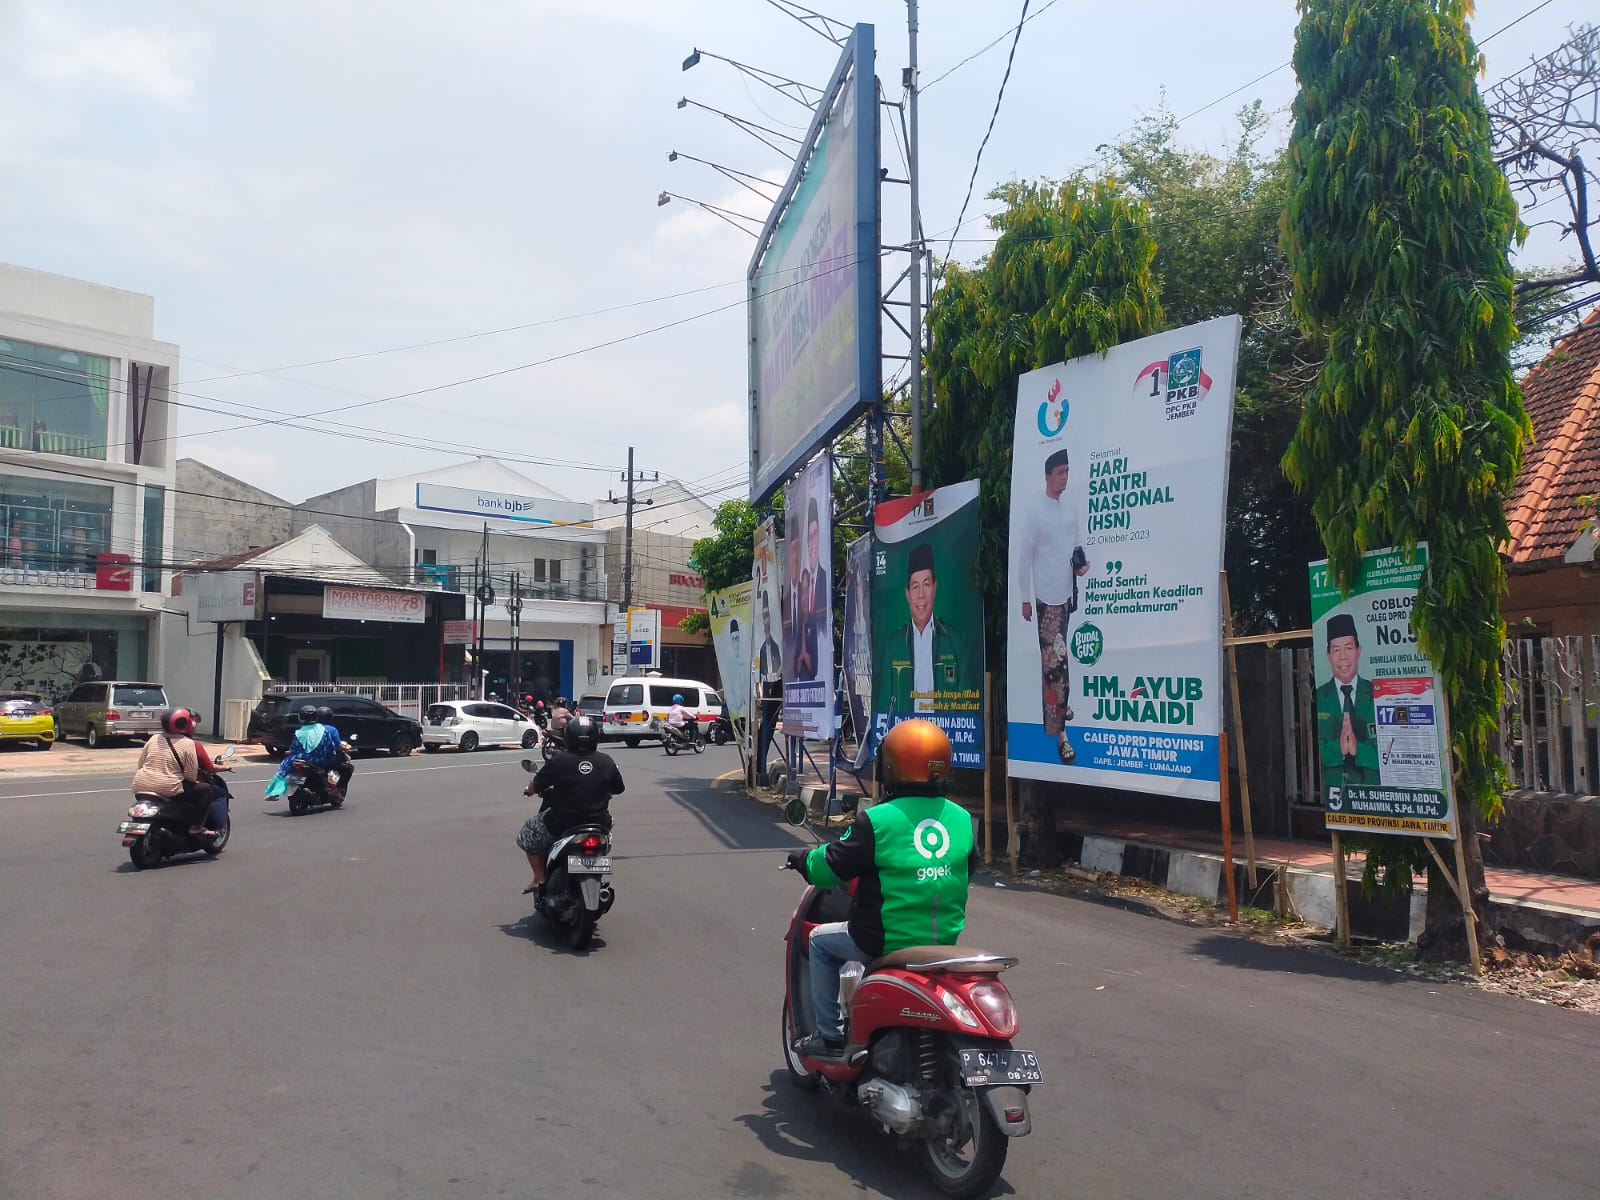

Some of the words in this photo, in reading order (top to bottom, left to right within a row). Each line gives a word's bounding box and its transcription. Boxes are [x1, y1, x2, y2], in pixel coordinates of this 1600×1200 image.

[1150, 368, 1160, 397] 1
[1166, 387, 1198, 403] PKB
[1166, 404, 1181, 416] DPC
[1182, 401, 1197, 412] PKB
[1166, 409, 1195, 421] JEMBER
[1090, 447, 1121, 461] Selamat
[1089, 457, 1128, 479] HARI
[1089, 472, 1147, 496] SANTRI
[477, 496, 503, 509] bank
[504, 500, 522, 512] bjb
[1088, 486, 1174, 513] NASIONAL
[1087, 510, 1131, 534] (HSN)
[1086, 536, 1096, 546] 22
[1098, 532, 1127, 545] Oktober
[1130, 530, 1150, 541] 2023
[876, 555, 886, 567] 14
[1085, 577, 1113, 590] Jihad
[1115, 574, 1147, 587] Santri
[332, 591, 397, 603] MARTABAK
[401, 597, 419, 611] 78
[1085, 589, 1150, 602] Mewujudkan
[1153, 585, 1203, 599] Keadilan
[1084, 604, 1104, 615] dan
[1366, 613, 1387, 622] CALEG
[1388, 610, 1407, 620] DPRD
[1075, 631, 1100, 646] BUDAL
[1077, 643, 1095, 659] GUS
[1083, 675, 1125, 698] HM.
[1130, 677, 1203, 701] AYUB
[1092, 699, 1193, 725] JUNAIDI
[1379, 707, 1395, 723] 17
[876, 713, 889, 740] 5
[951, 717, 976, 729] ABDUL
[1084, 731, 1116, 744] CALEG
[1118, 733, 1146, 747] DPRD
[1149, 736, 1203, 752] PROVINSI
[959, 753, 980, 763] TIMUR
[1106, 746, 1141, 759] JAWA
[1142, 748, 1177, 762] TIMUR
[1094, 757, 1112, 766] DAPIL
[1117, 758, 1143, 769] JEMBER
[1150, 762, 1192, 774] LUMAJANG
[1328, 787, 1342, 811] 5
[1348, 790, 1358, 799] Dr.
[1359, 790, 1368, 799] H.
[1369, 791, 1411, 802] SUHERMIN
[1412, 793, 1440, 804] ABDUL
[1327, 815, 1347, 824] CALEG
[1348, 816, 1366, 825] DPRD
[1401, 821, 1421, 830] JAWA
[916, 865, 951, 880] gojek
[963, 1053, 970, 1067] P
